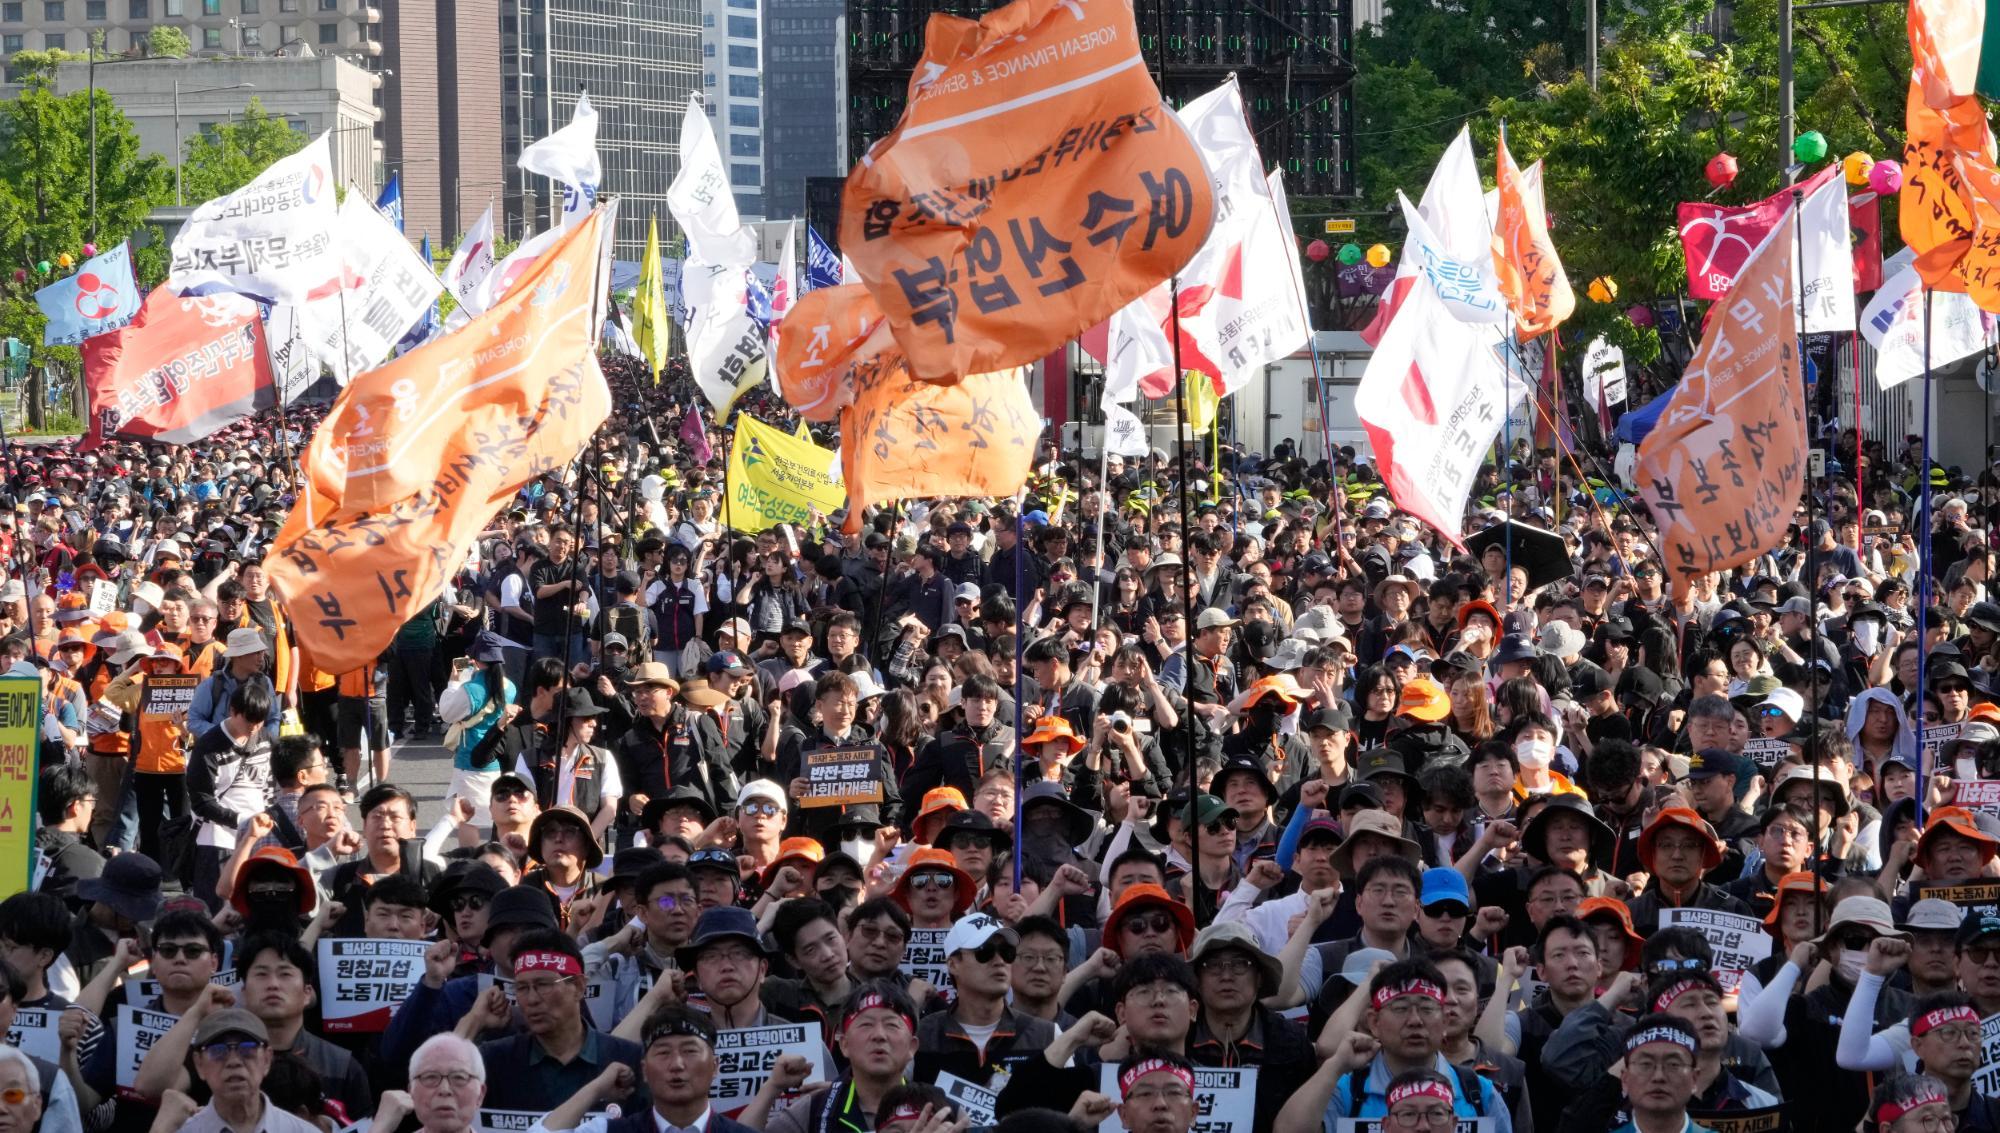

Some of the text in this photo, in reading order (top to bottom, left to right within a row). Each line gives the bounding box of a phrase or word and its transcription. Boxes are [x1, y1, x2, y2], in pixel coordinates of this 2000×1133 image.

[145, 701, 193, 715] 사회대개
[0, 744, 28, 781] 적인
[810, 763, 871, 781] 반전·평화
[1951, 886, 1986, 900] 노동자
[1713, 914, 1760, 934] 염원이다!
[342, 941, 376, 956] 열사의
[540, 952, 568, 971] 투쟁
[335, 983, 416, 1004] 노동기본
[744, 1028, 801, 1046] 염원이다!
[713, 1049, 784, 1075] 청교섭
[708, 1075, 770, 1100] 동기
